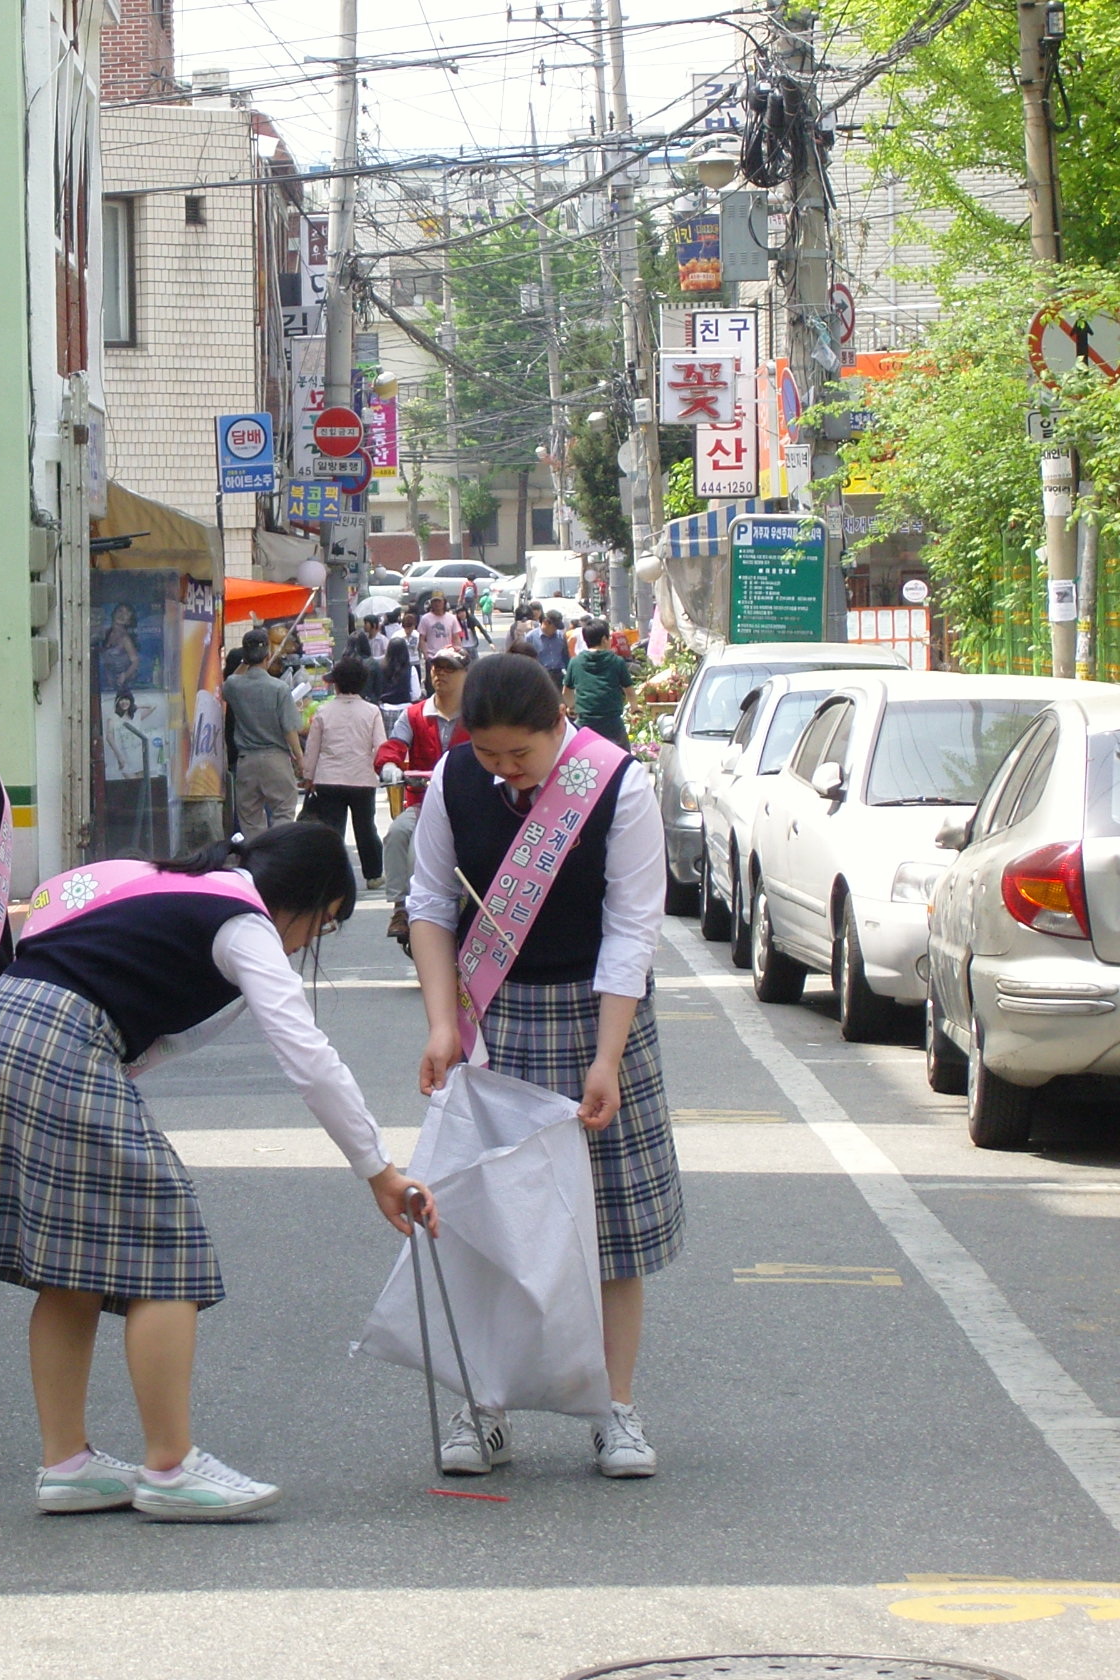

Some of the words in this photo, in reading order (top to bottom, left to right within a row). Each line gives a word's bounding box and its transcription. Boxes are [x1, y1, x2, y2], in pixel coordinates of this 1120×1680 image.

[700, 318, 750, 342] 친구
[667, 362, 728, 419] 꽃
[231, 428, 262, 446] 담배
[320, 428, 356, 436] 진입금지
[317, 461, 359, 472] 일방통행
[225, 474, 273, 489] 하이트소주
[701, 481, 753, 494] 444-1250
[736, 524, 748, 540] P
[511, 821, 546, 868] 꿈을
[535, 807, 582, 874] 세계로
[477, 874, 519, 937] 이루는
[510, 879, 544, 925] 가는
